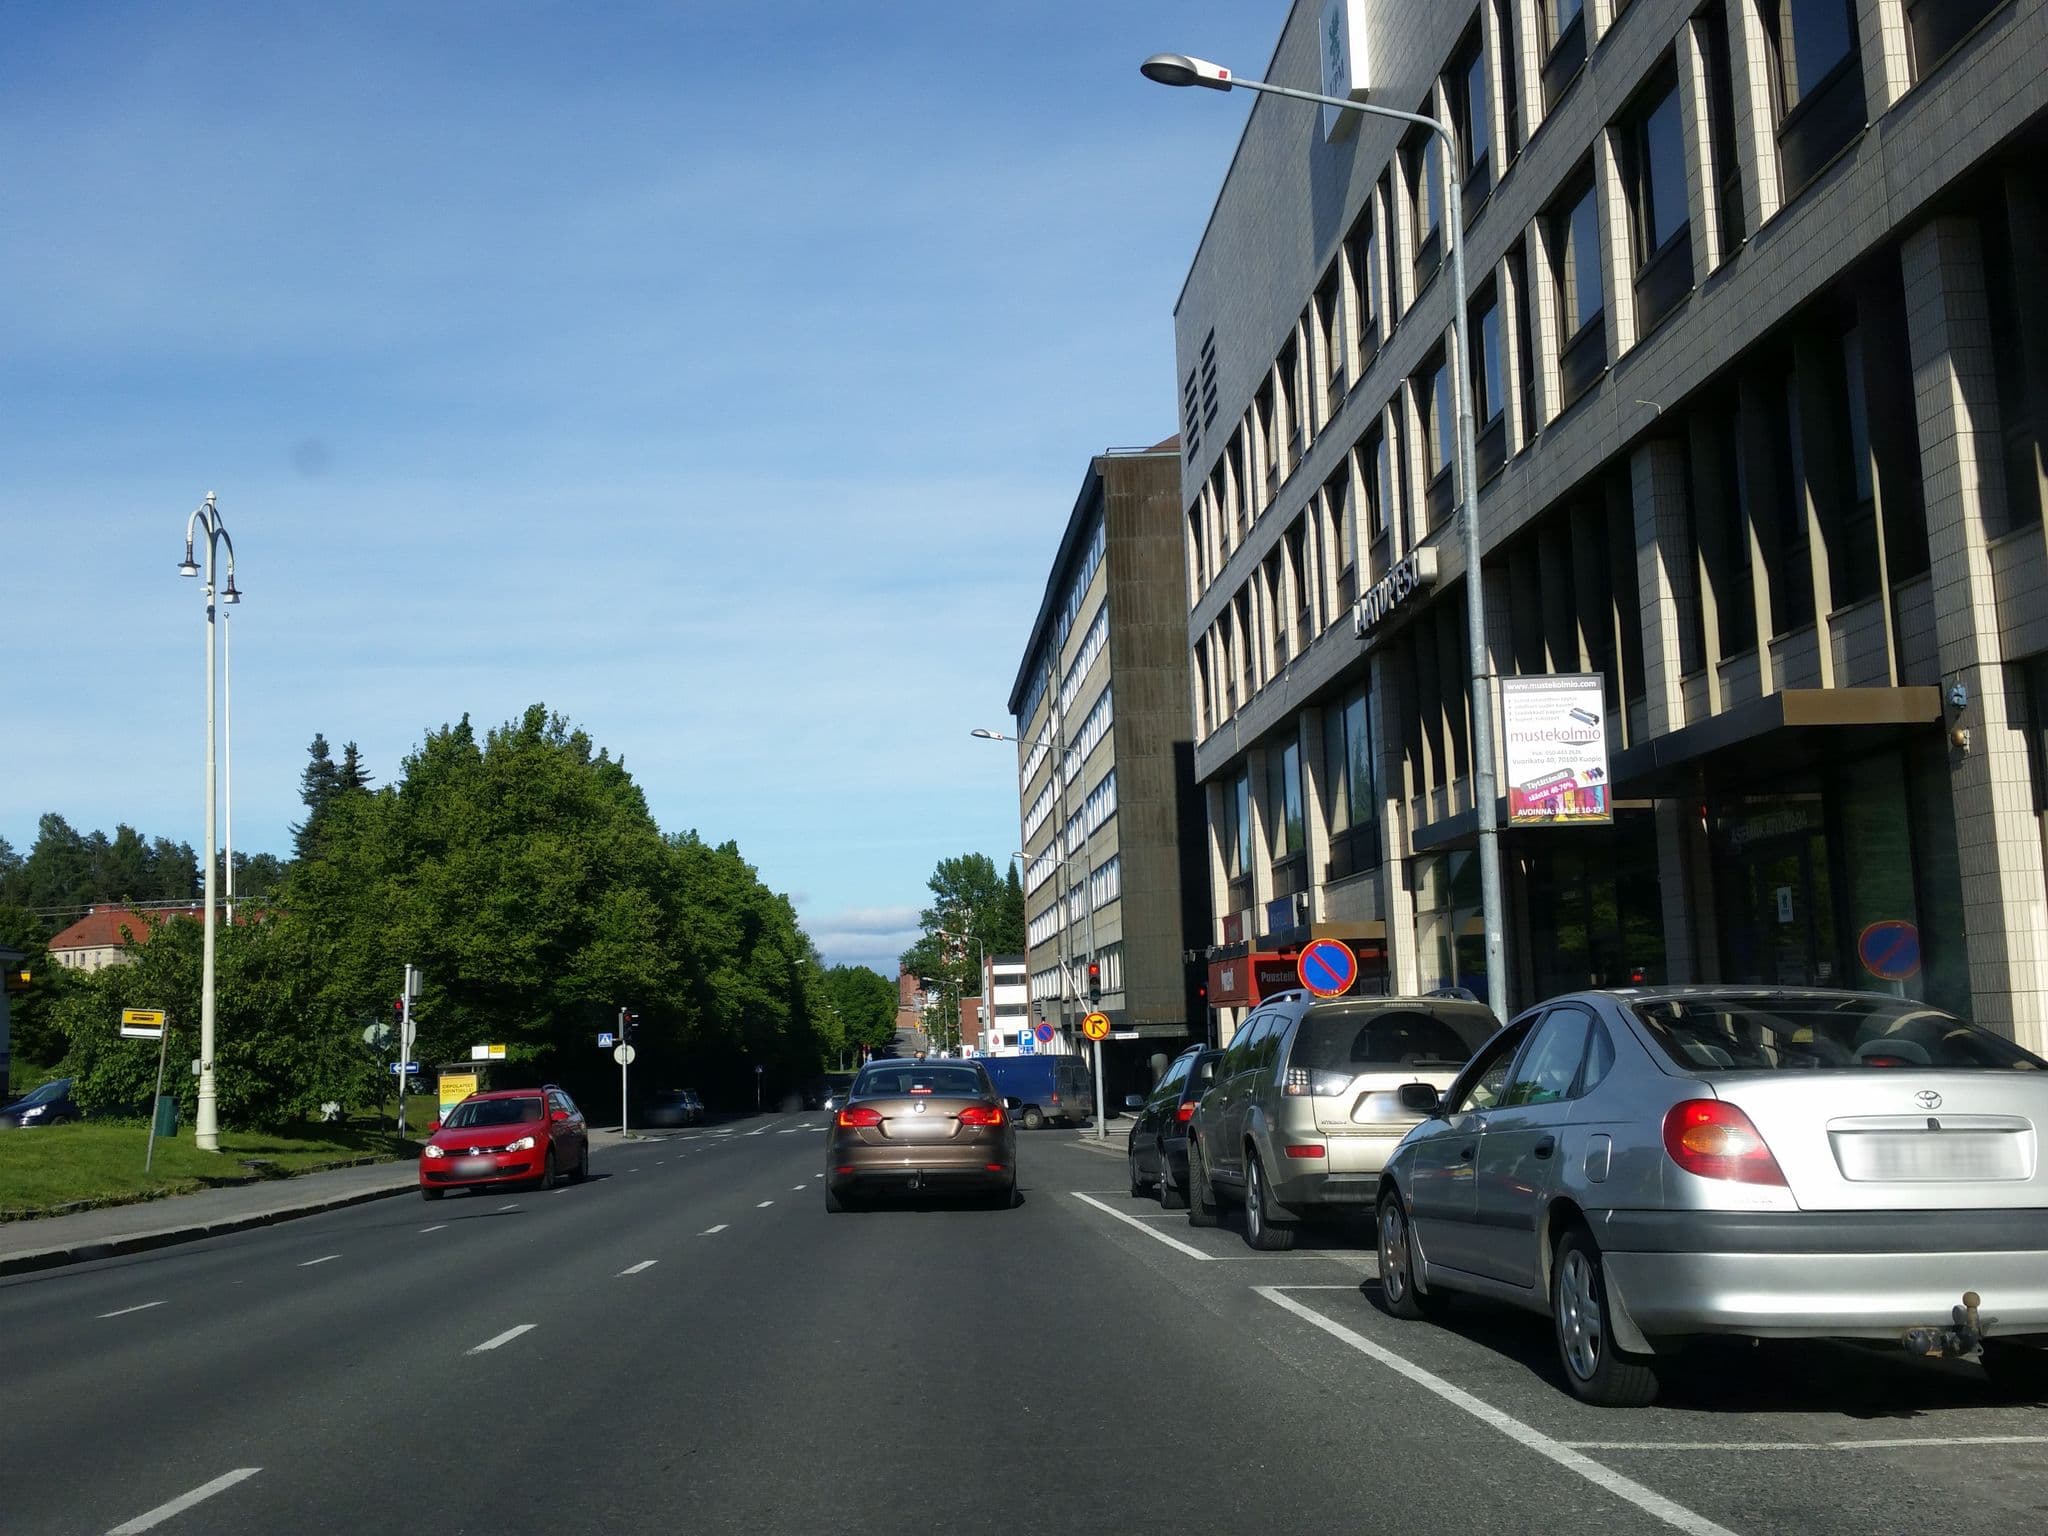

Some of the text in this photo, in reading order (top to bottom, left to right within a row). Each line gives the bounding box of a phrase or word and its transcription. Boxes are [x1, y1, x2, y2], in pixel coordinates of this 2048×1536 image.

[1507, 680, 1597, 690] www.mustekolmio.com
[1511, 727, 1601, 742] mustekolmio
[1579, 756, 1601, 764] Kuopio
[1517, 807, 1555, 816] AVOINNA:
[1021, 1031, 1033, 1045] P
